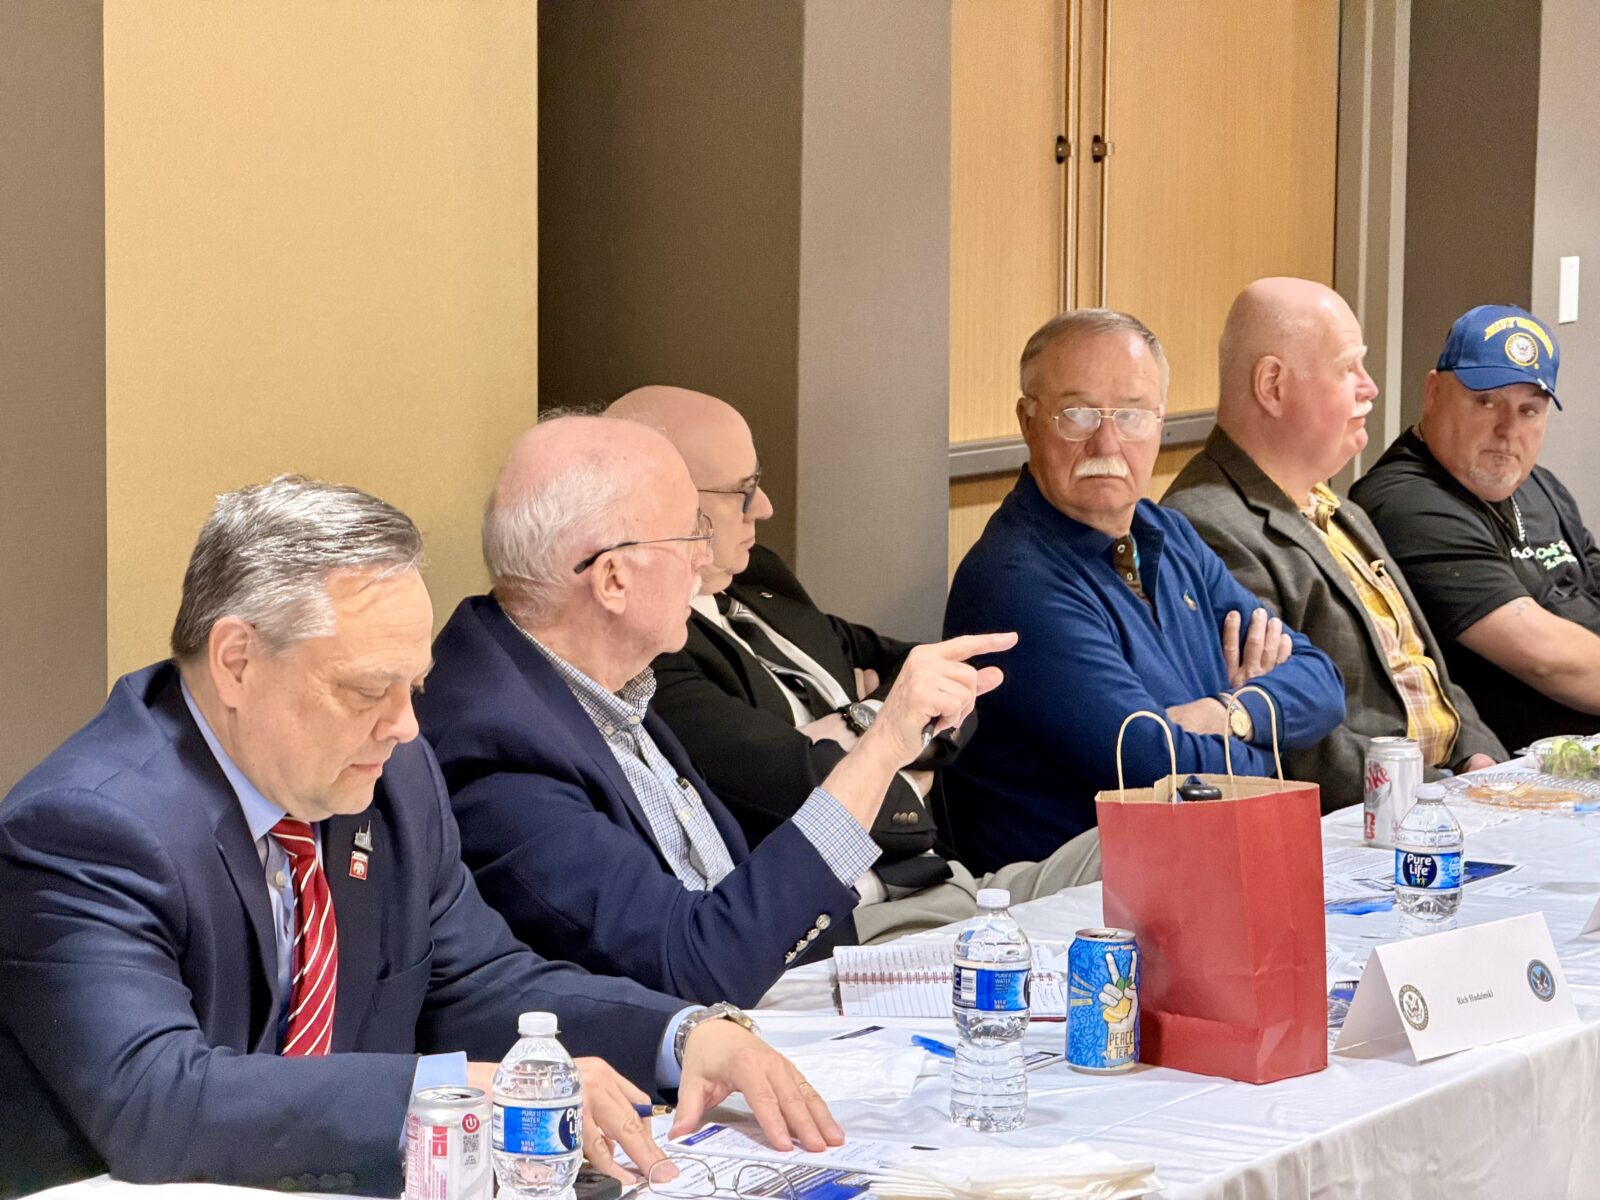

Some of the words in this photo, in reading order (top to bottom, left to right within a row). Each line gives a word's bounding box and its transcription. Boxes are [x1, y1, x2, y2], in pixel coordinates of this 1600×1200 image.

[1364, 767, 1390, 794] oke
[1407, 854, 1432, 866] Pure
[1410, 864, 1429, 878] Life
[1109, 1030, 1134, 1047] PEACE
[1114, 1046, 1129, 1059] TEA
